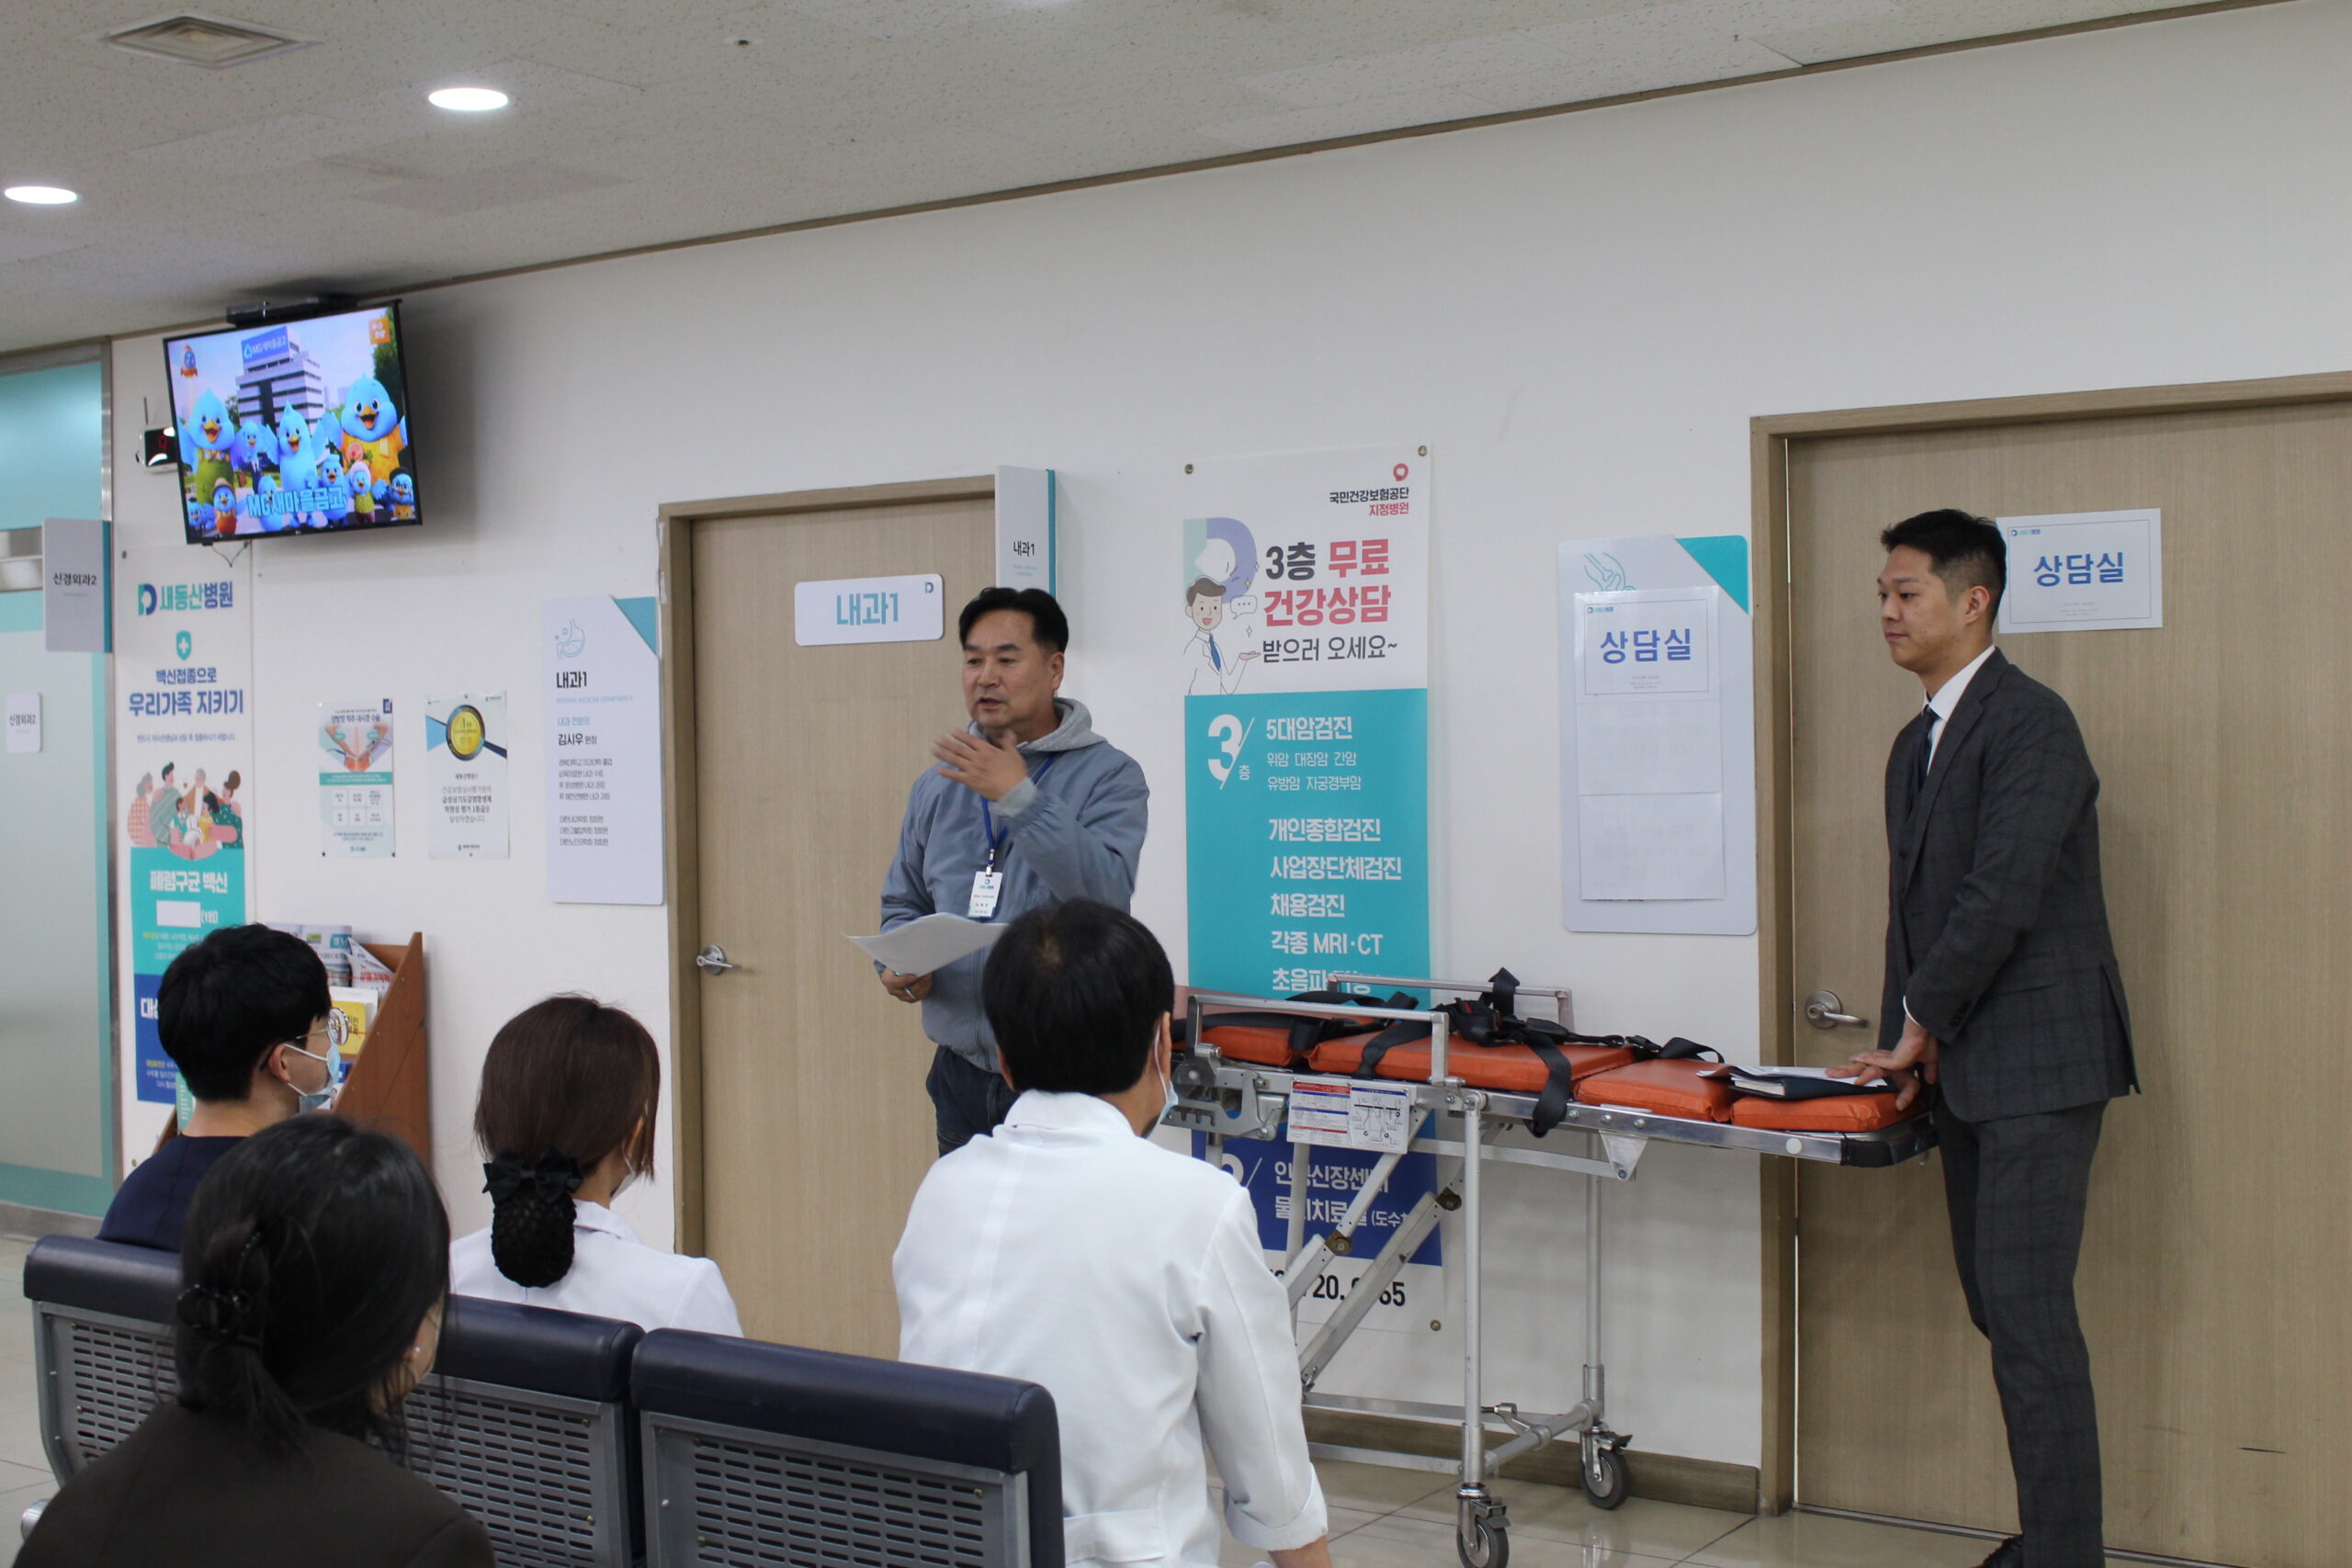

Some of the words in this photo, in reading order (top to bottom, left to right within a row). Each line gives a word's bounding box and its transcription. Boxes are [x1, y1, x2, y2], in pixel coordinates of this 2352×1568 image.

[247, 486, 345, 517] MG새마을금고
[1329, 486, 1410, 504] 국민건강보험공단
[1368, 502, 1410, 517] 지정병원
[1012, 540, 1035, 557] 내과1
[1265, 542, 1317, 581] 3층
[1329, 538, 1390, 579] 무료
[52, 572, 96, 586] 신경외과2
[2033, 551, 2125, 588] 상담실
[160, 581, 233, 612] 새동산병원
[1263, 584, 1392, 627] 건강상담
[836, 592, 899, 626] 내과1
[1262, 637, 1320, 663] 받으러
[1327, 635, 1398, 660] 오세요~
[1600, 627, 1691, 664] 상담실
[156, 668, 217, 685] 백신접종으로
[556, 671, 587, 689] 내과1
[129, 691, 192, 716] 우리가족
[197, 689, 243, 715] 지키기
[8, 713, 36, 727] 신경외과2
[1266, 716, 1353, 741] 5대암검진
[558, 733, 583, 746] 김시우
[1266, 752, 1289, 767] 위암
[1295, 751, 1329, 767] 대장암
[1334, 751, 1357, 766] 간암
[1267, 775, 1300, 791] 유방암
[1306, 774, 1362, 791] 자궁경부암
[1269, 818, 1382, 842] 개인종합검진
[1270, 855, 1402, 881] 사업장단체검진
[149, 871, 200, 893] 폐렴구균
[202, 871, 228, 894] 백신
[1271, 893, 1346, 919] 채용검진
[1272, 931, 1308, 954] 각종
[1313, 932, 1384, 955] MRI·CT
[1272, 967, 1329, 992] 초음파
